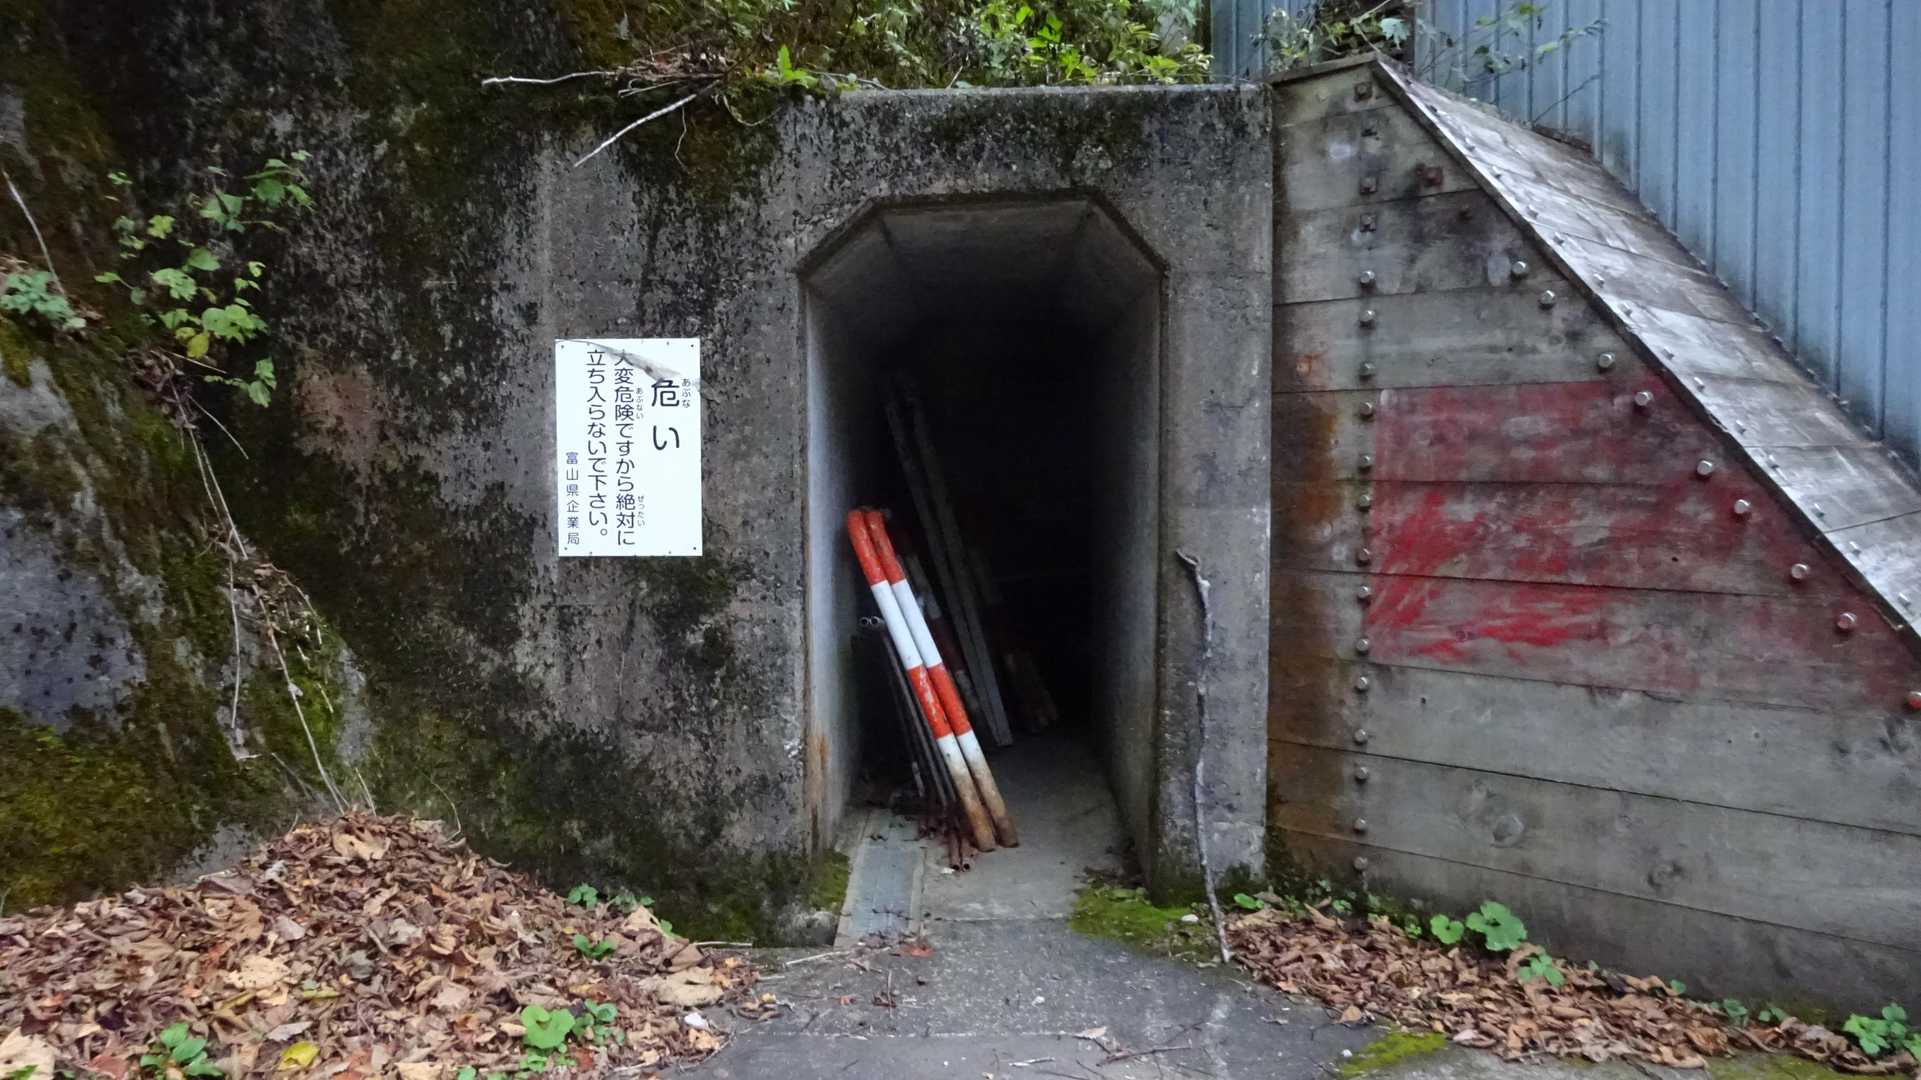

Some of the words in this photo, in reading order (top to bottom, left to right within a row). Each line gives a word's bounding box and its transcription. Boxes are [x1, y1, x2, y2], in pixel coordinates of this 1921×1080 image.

[586, 349, 608, 537] 立ち入らないで下さい。
[651, 378, 680, 451] 危い
[565, 451, 580, 545] 富山県企業局
